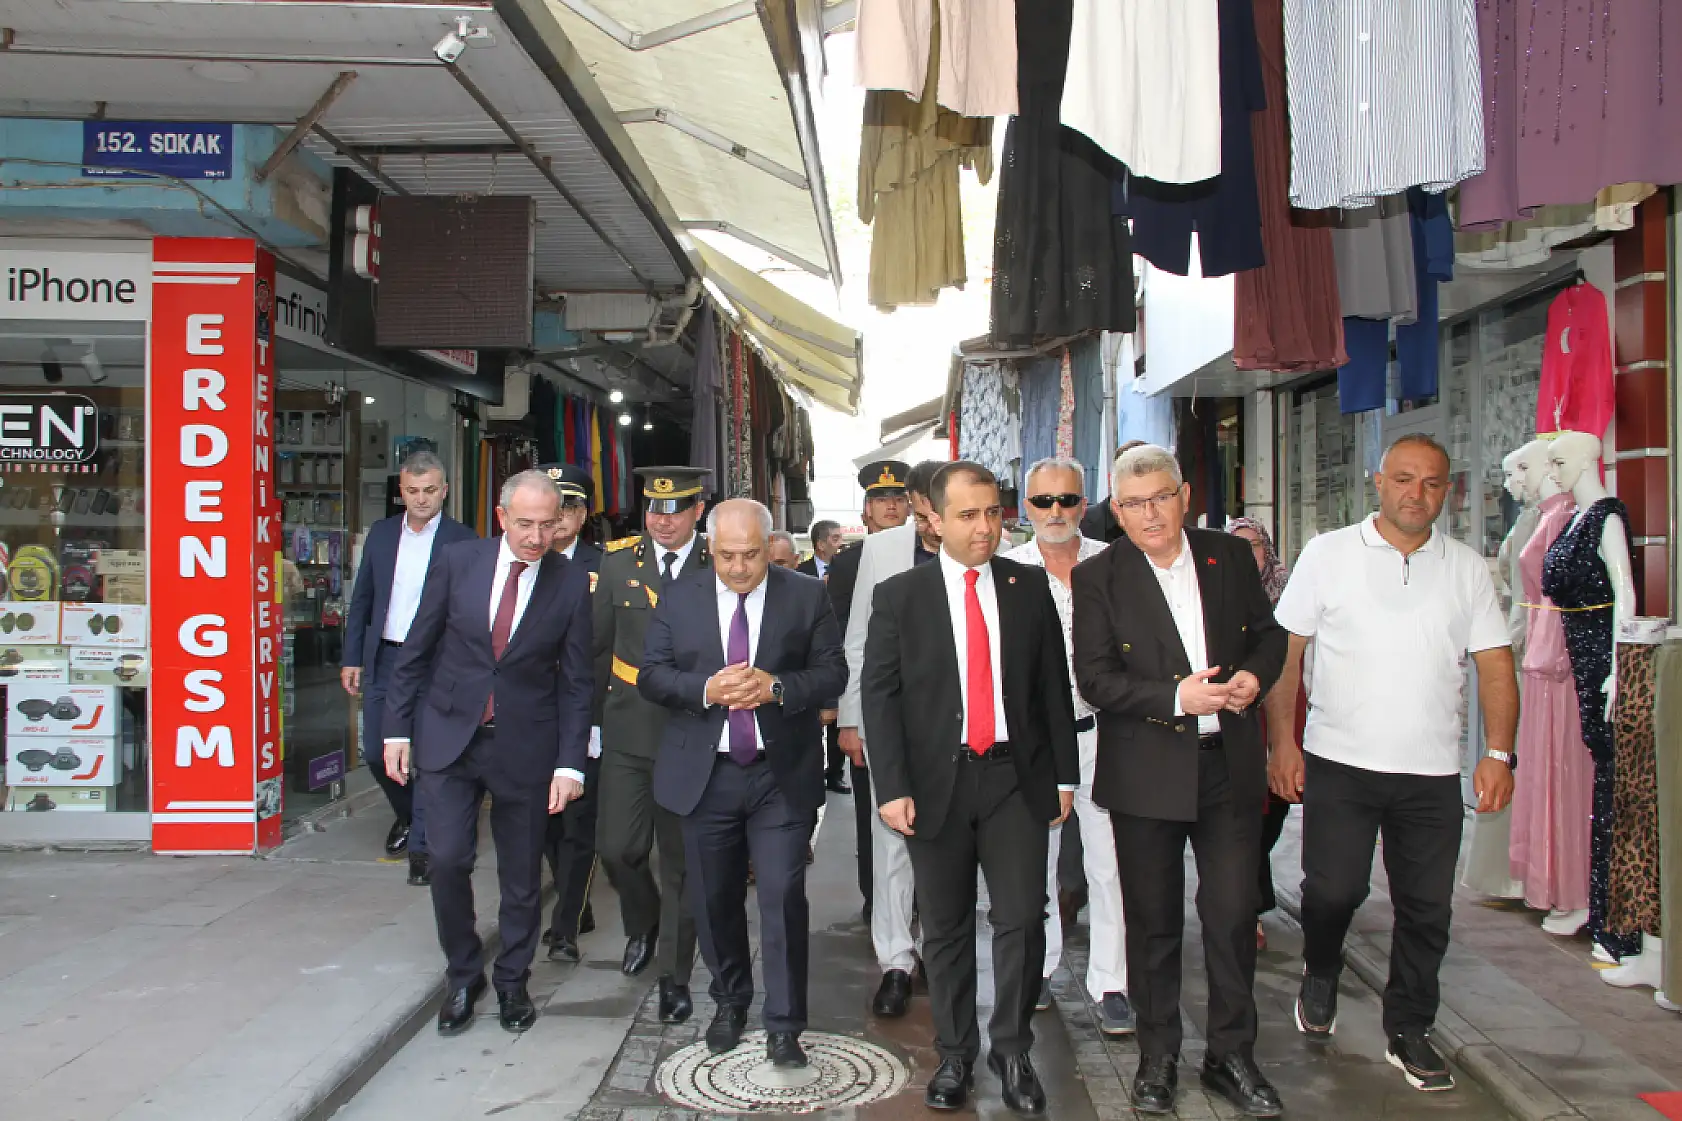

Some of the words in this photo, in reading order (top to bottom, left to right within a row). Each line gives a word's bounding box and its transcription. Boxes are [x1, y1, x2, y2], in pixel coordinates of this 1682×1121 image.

[97, 132, 142, 153] 152.
[149, 132, 221, 154] SOKAK
[8, 267, 136, 304] iPhone
[179, 312, 230, 579] ERDEN
[173, 612, 236, 769] GSM
